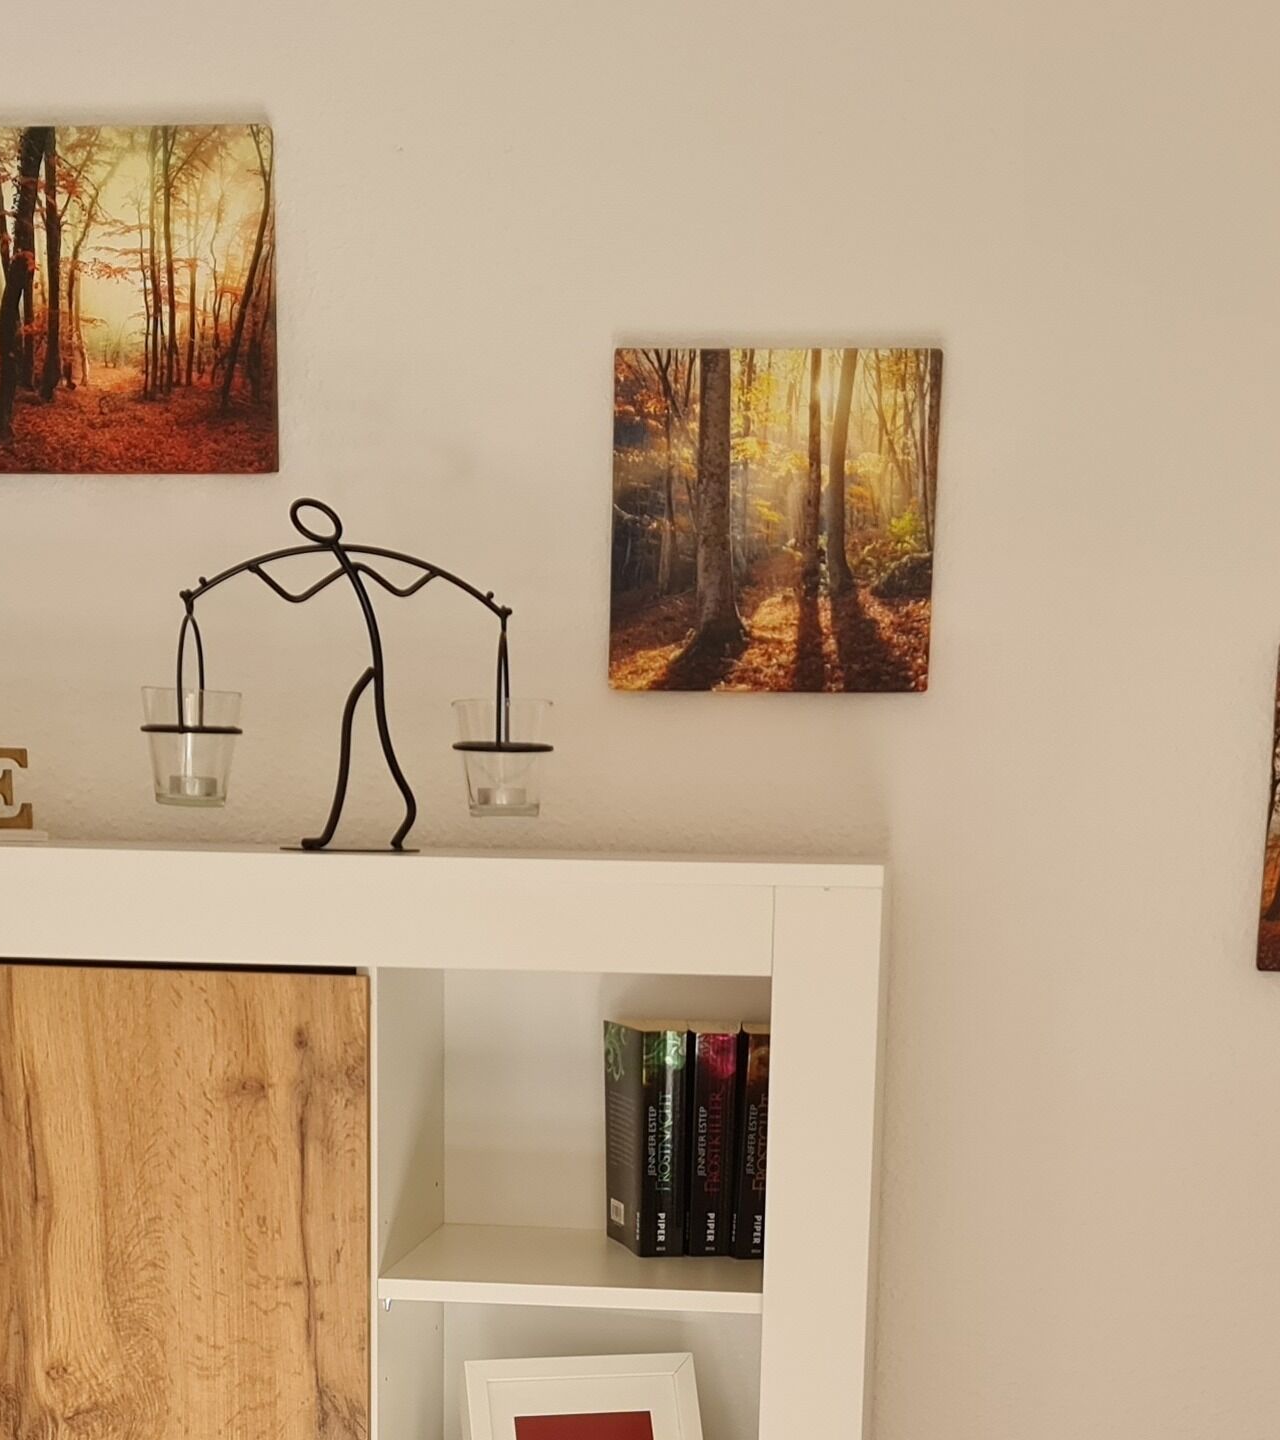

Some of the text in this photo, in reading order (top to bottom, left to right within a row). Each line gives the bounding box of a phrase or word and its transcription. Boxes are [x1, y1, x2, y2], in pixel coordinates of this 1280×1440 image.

[648, 1106, 657, 1175] JENNIFER ESTEP
[655, 1092, 672, 1192] FROSTNACHT
[698, 1106, 707, 1176] JENNIFER ESTEP
[704, 1092, 722, 1194] FROSTKILLER
[746, 1104, 758, 1174] JENNIFER ESTEP
[657, 1212, 665, 1241] PIPER
[706, 1212, 715, 1241] PIPER
[753, 1215, 762, 1244] PIPER
